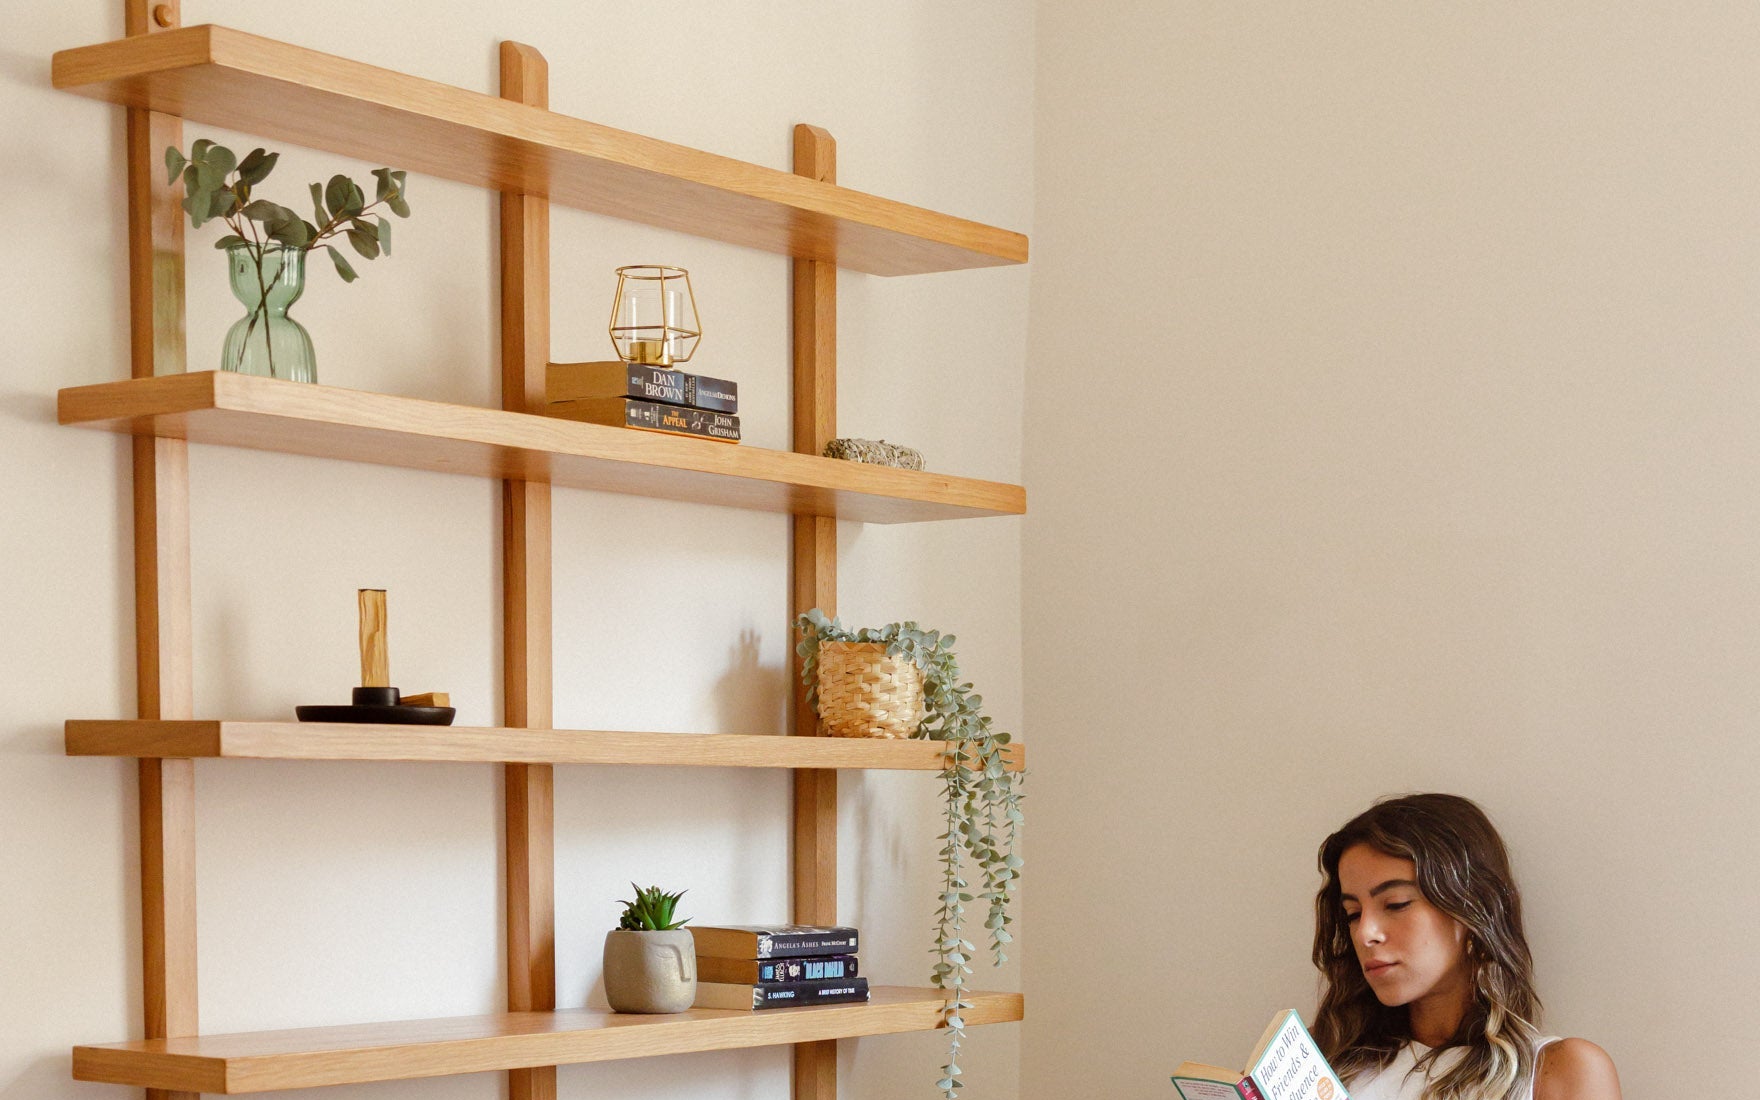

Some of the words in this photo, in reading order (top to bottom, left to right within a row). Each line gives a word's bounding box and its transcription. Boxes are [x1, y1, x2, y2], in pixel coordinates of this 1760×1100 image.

[653, 371, 675, 387] DAN
[645, 383, 683, 400] BROWN
[663, 414, 688, 428] APPEAL
[714, 415, 732, 427] JOHN
[708, 425, 739, 439] GRISHAM
[774, 942, 800, 950] ANGELA'S
[801, 940, 819, 948] ASHES
[767, 992, 772, 1000] S.
[772, 991, 795, 999] HAWKING
[1260, 1055, 1278, 1086] How
[1276, 1047, 1286, 1062] to
[1281, 1025, 1300, 1051] Win
[1299, 1043, 1310, 1059] &
